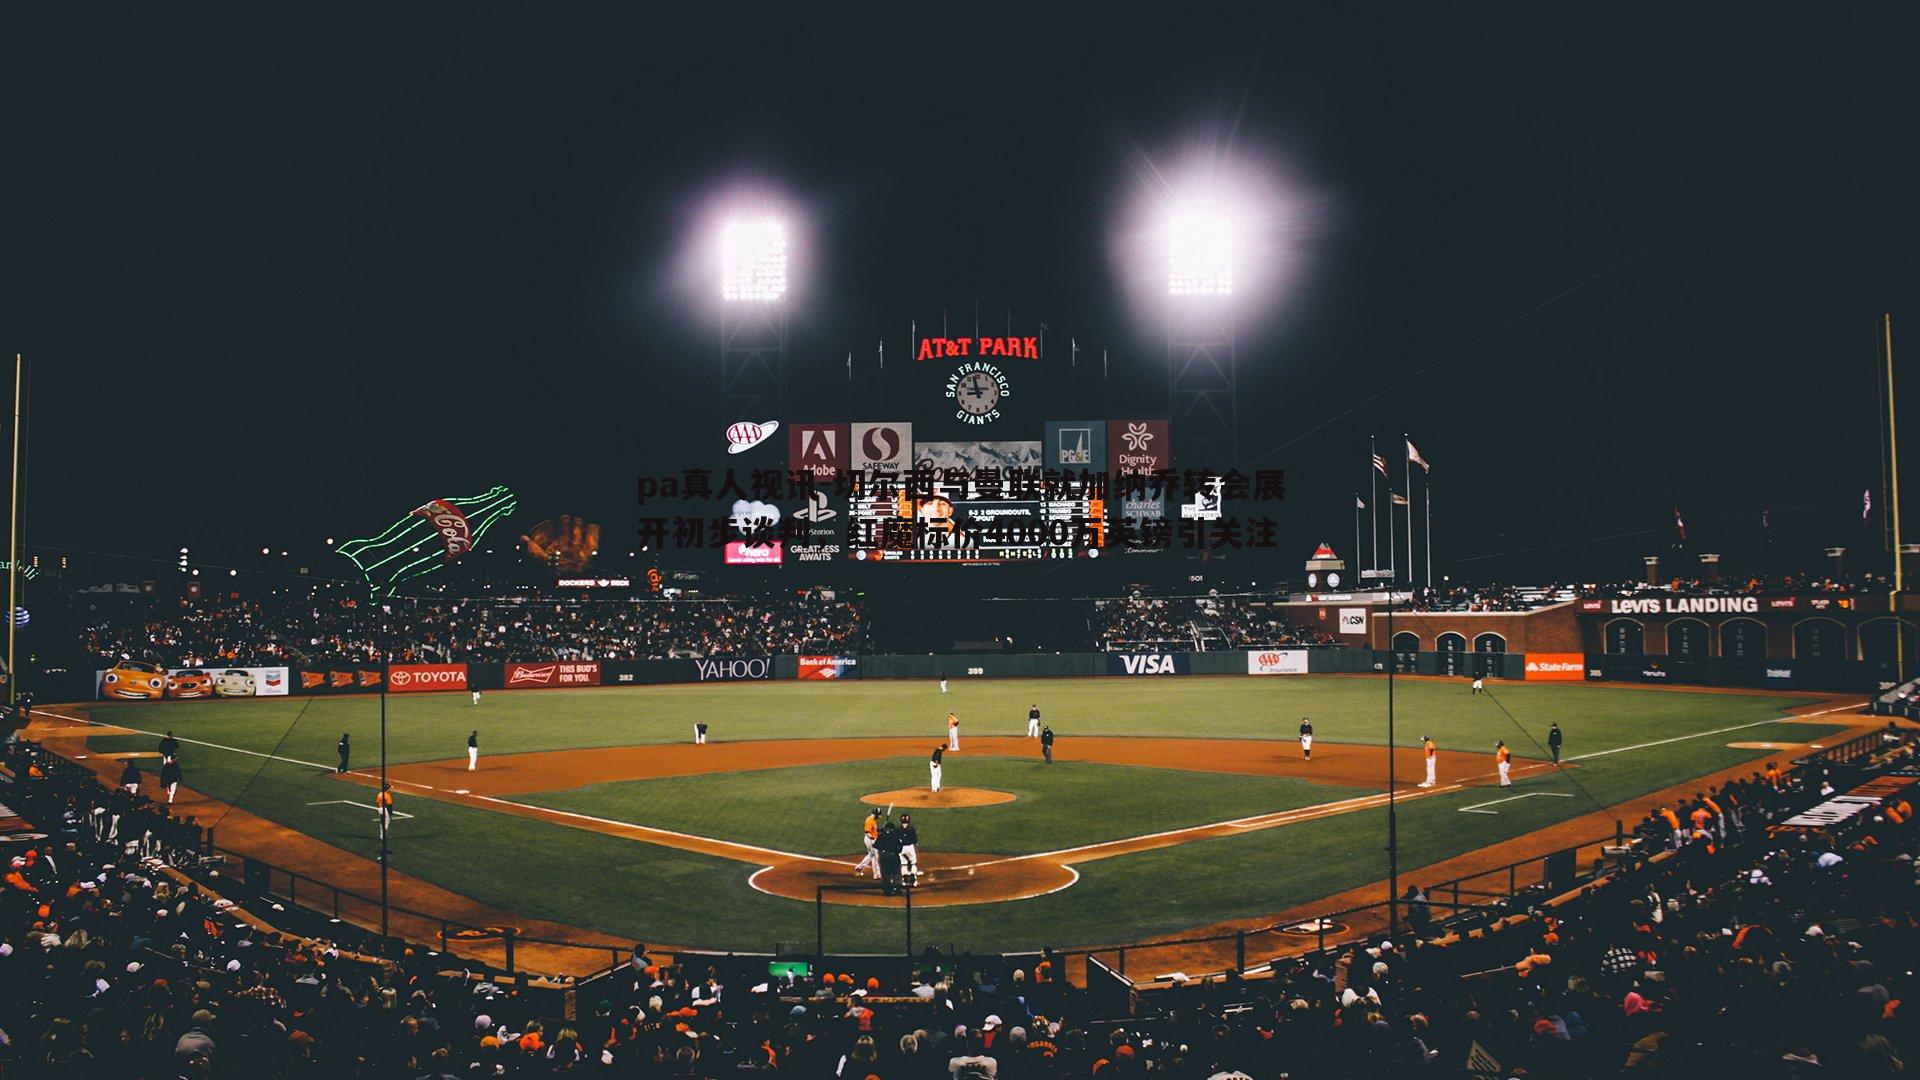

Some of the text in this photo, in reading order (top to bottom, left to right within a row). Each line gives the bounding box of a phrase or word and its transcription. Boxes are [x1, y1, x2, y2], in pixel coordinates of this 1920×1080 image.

[918, 337, 1038, 361] AT&T PARK
[945, 361, 1010, 398] SAN FRANCISCO
[956, 409, 1000, 425] GIANTS
[862, 462, 899, 470] SAFEWAY
[1119, 454, 1157, 467] Dignity
[1125, 499, 1160, 510] charles
[1125, 510, 1161, 518] SCHWAB
[798, 553, 832, 562] AWAITS
[558, 579, 630, 587] DOCKERS DECK
[1665, 597, 1758, 613] LANDING
[1349, 616, 1364, 625] CSN
[800, 657, 857, 666] Bank of America
[1118, 655, 1175, 674] VISA
[559, 664, 597, 673] THIS BUD'S
[696, 658, 770, 681] YAHOO!
[413, 671, 467, 682] TOYOTA
[559, 674, 591, 682] FOR YOU.
